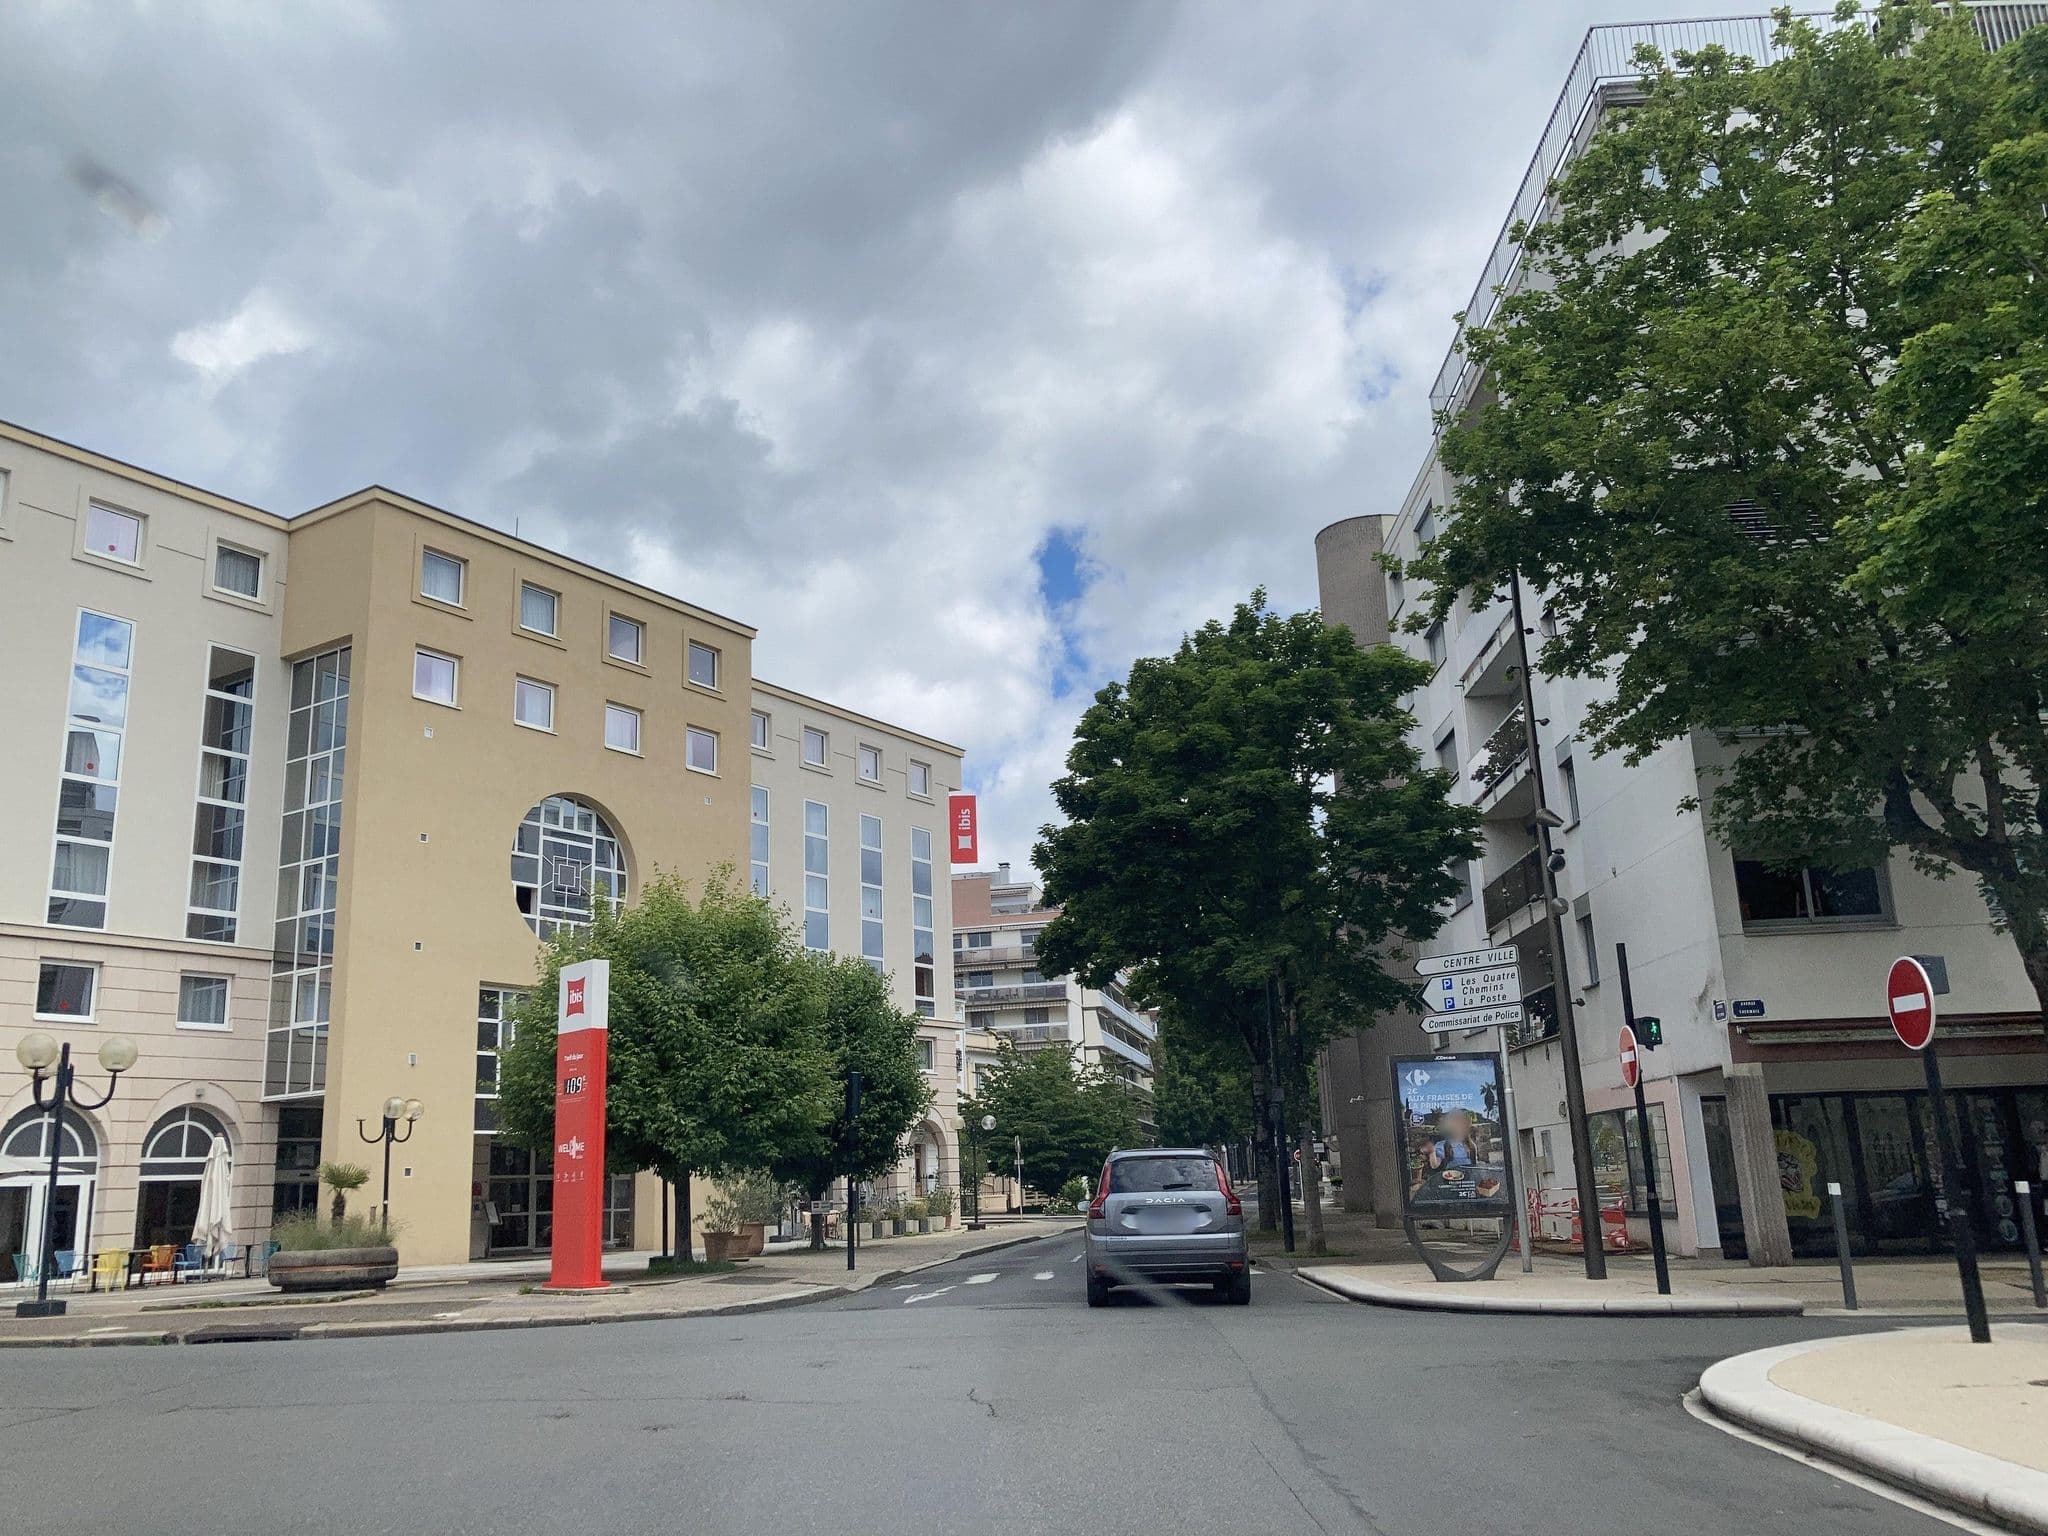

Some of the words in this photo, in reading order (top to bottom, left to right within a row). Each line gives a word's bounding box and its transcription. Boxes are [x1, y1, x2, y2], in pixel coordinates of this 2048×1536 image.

[958, 808, 971, 830] ibis
[1443, 955, 1480, 969] CENTRE
[1488, 950, 1514, 962] VILLE
[1461, 977, 1476, 986] Les
[1483, 971, 1516, 983] Quatre
[569, 989, 583, 1005] ibis
[1462, 983, 1504, 995] Chemins
[1463, 997, 1473, 1006] La
[1480, 993, 1507, 1004] Poste
[1428, 1015, 1480, 1029] Commissariat
[1483, 1013, 1493, 1022] de
[1495, 1010, 1520, 1021] Police
[566, 1076, 583, 1094] 109
[1426, 1094, 1460, 1102] FRAISES
